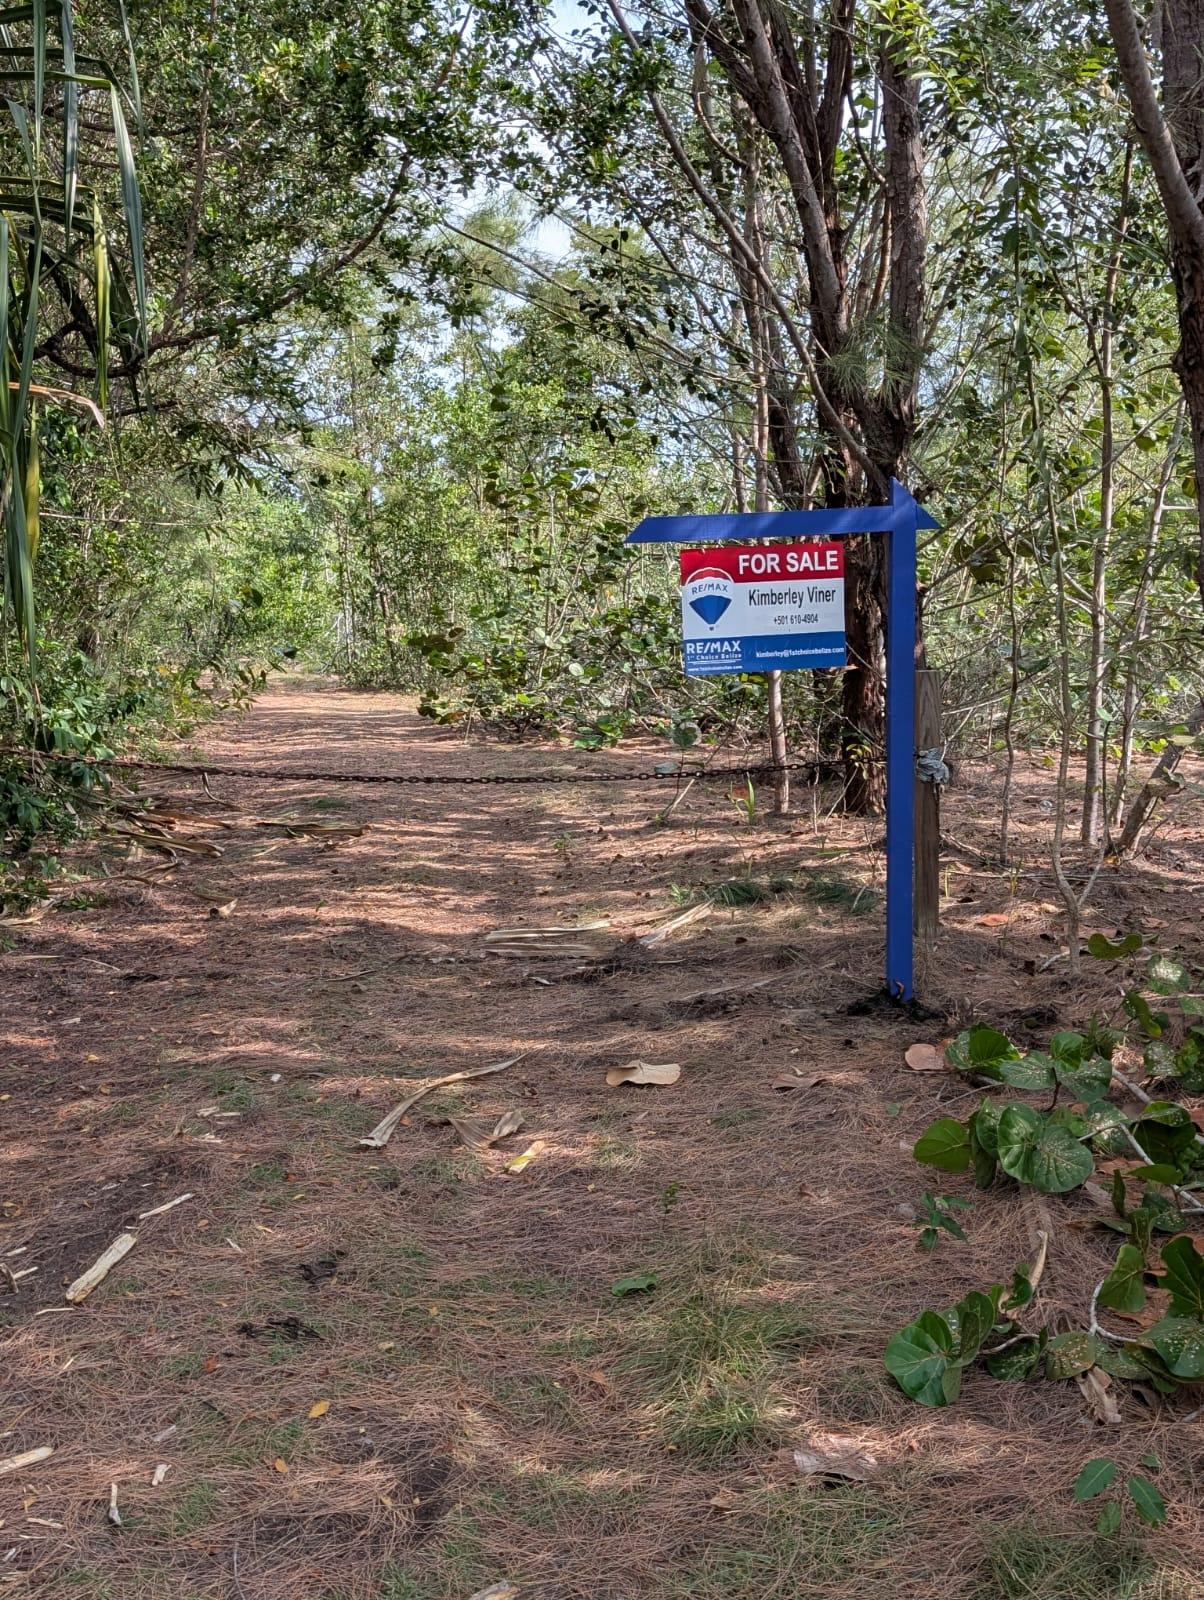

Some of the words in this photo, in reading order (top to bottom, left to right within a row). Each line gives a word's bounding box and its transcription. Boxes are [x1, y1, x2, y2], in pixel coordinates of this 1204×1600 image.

[738, 553, 781, 575] FOR
[786, 550, 839, 573] SALE
[691, 583, 729, 596] RE/MAX
[749, 588, 804, 609] Kimberley
[807, 586, 836, 603] Viner
[773, 616, 789, 626] +501
[790, 613, 819, 624] 610-4904
[686, 640, 742, 654] RE/MAX
